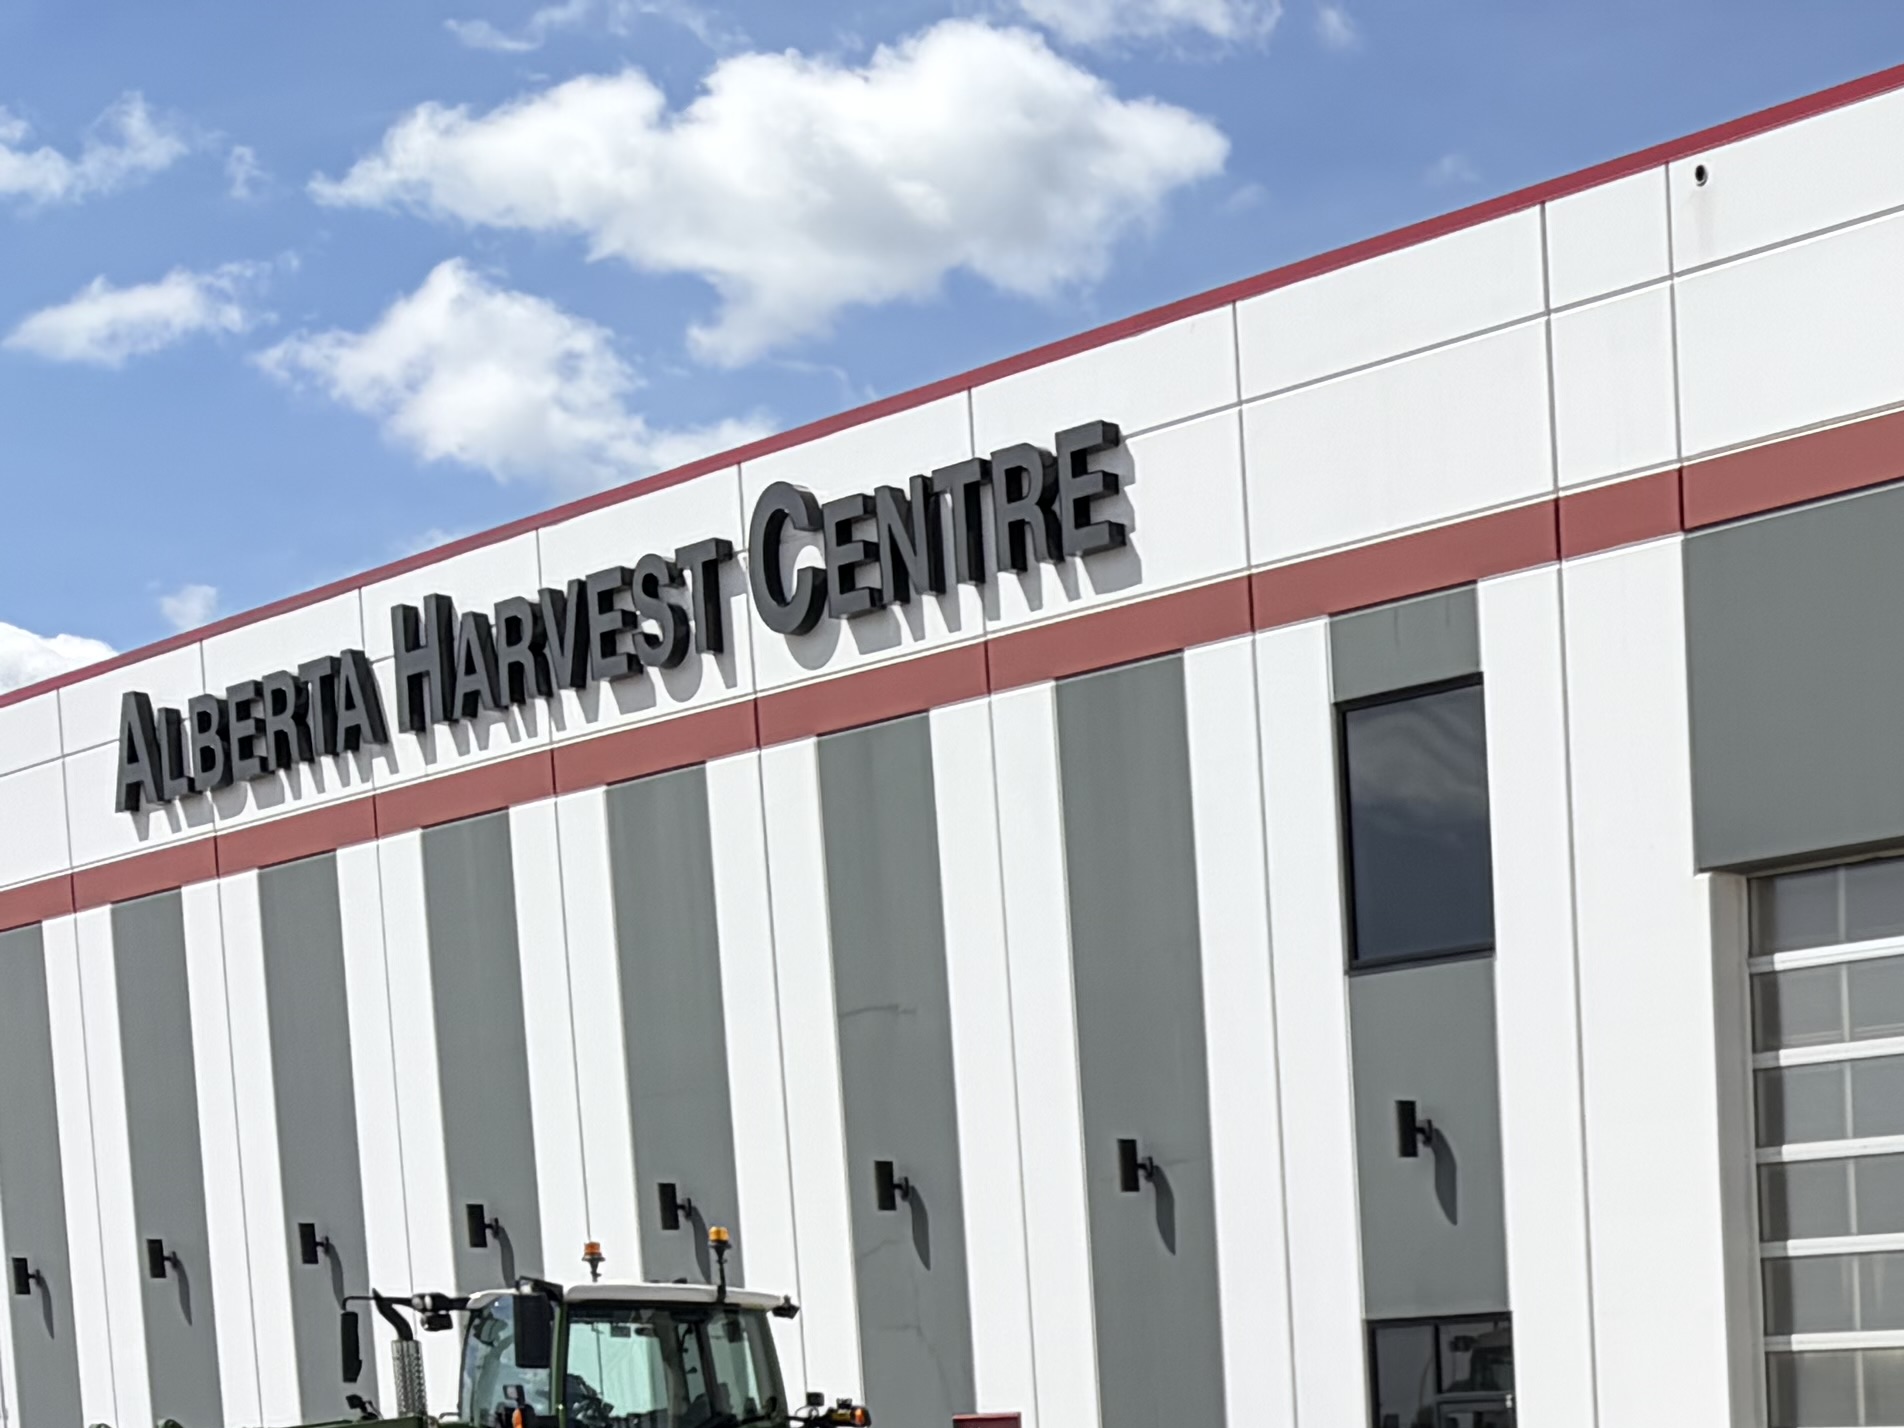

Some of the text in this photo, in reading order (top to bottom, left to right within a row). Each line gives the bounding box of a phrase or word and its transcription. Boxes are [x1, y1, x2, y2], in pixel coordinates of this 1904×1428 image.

[114, 419, 1128, 813] ALBERTA HARVEST CENTRE
